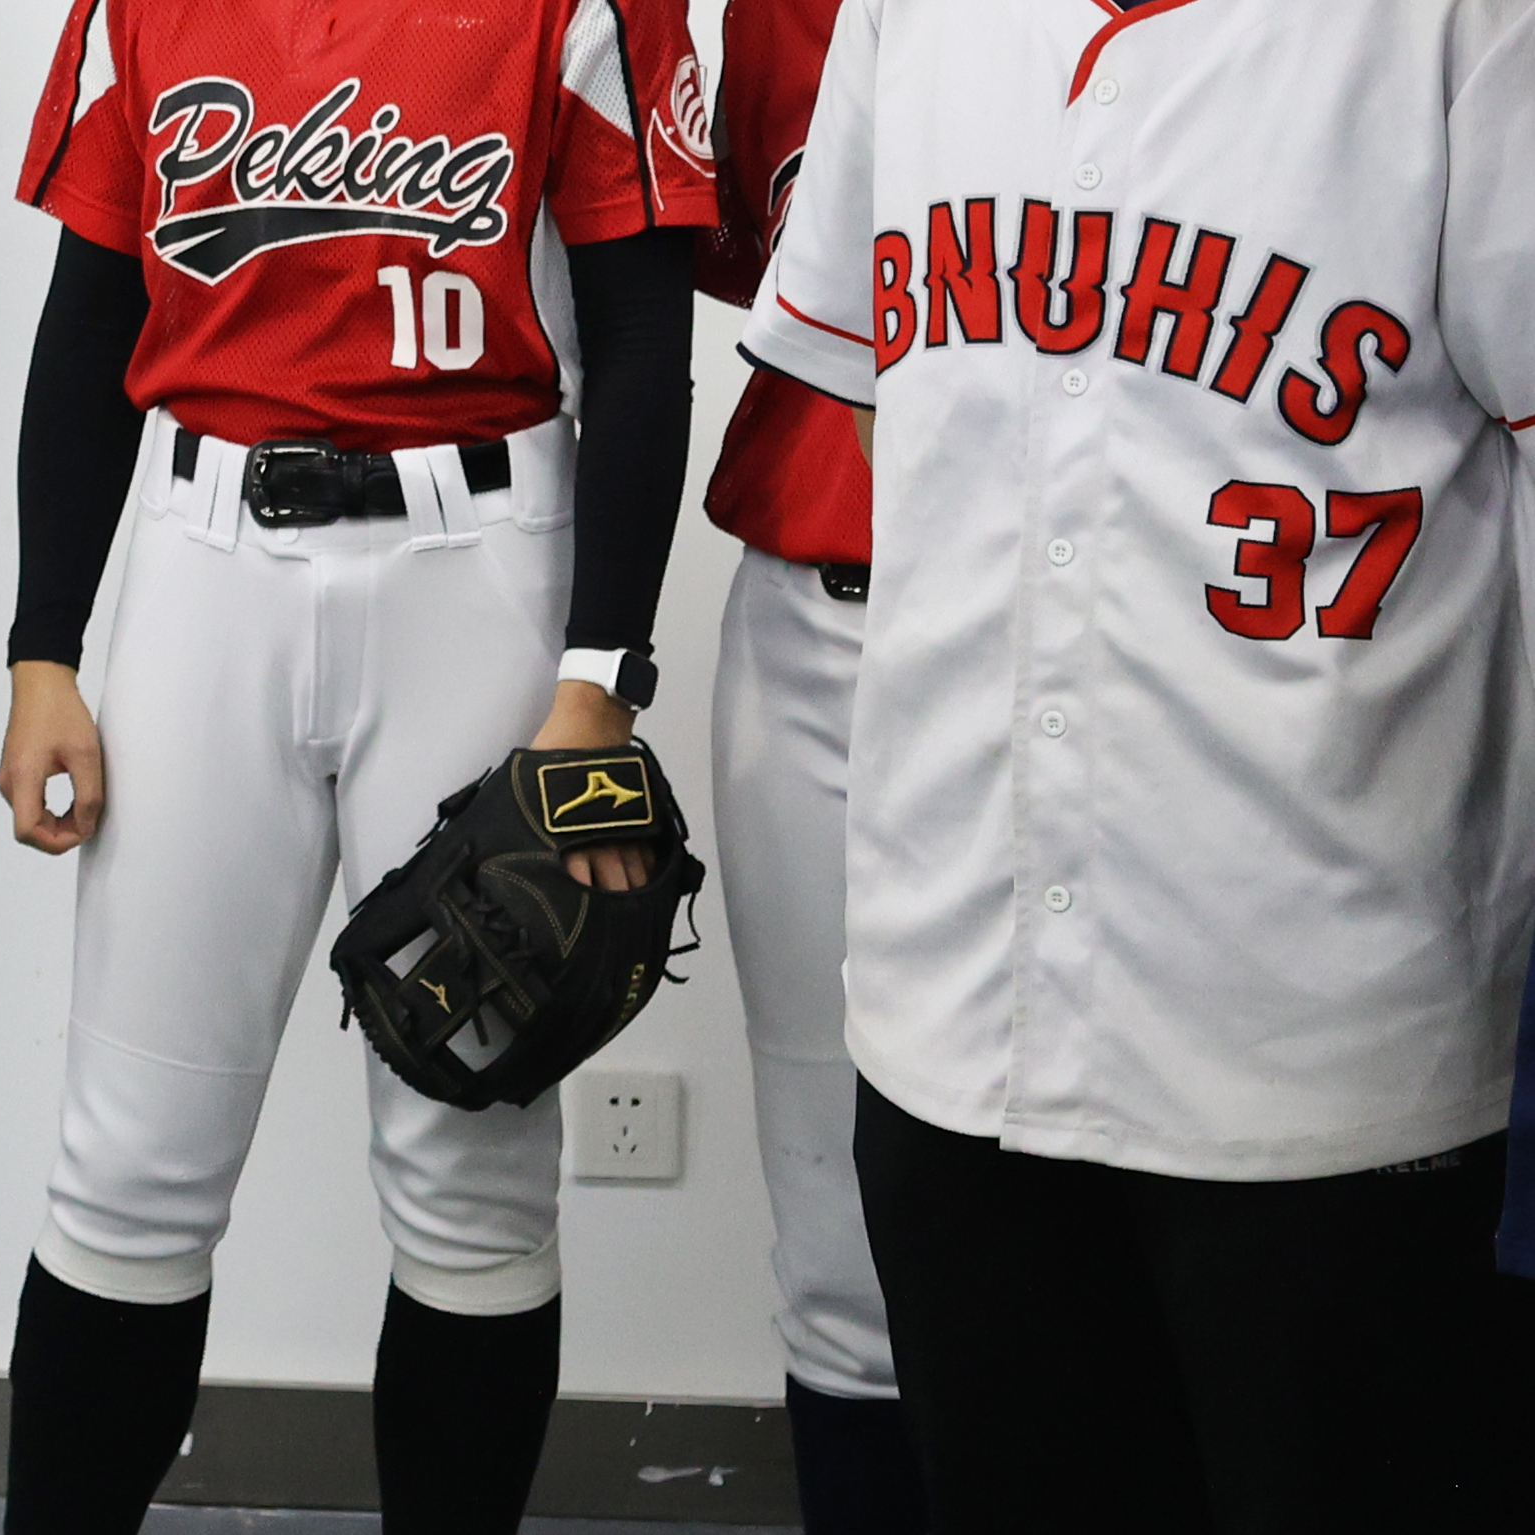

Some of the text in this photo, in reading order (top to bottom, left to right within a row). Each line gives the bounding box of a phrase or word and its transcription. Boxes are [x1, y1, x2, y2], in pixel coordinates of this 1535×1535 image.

[148, 76, 515, 258] Peking
[377, 265, 485, 371] 10
[873, 194, 1412, 447] BNUHIS
[1205, 479, 1424, 641] 37
